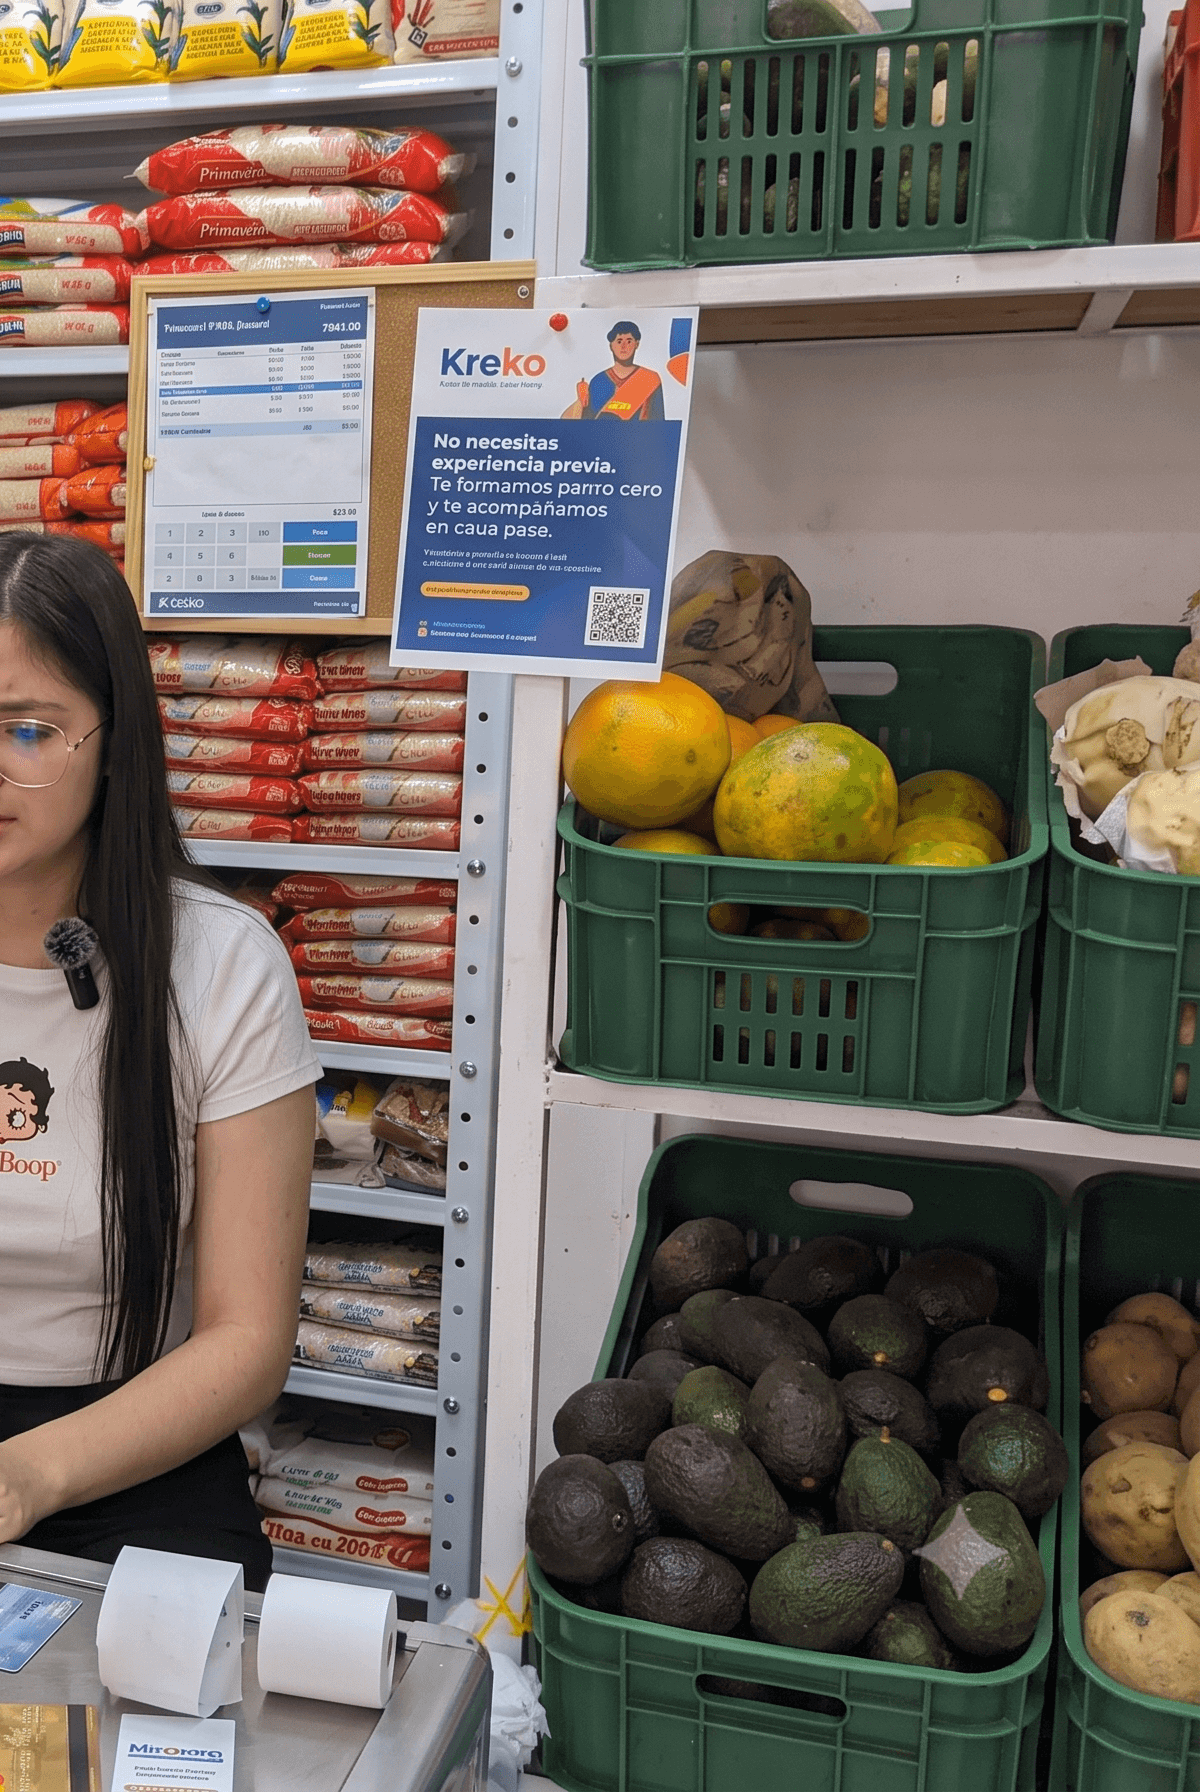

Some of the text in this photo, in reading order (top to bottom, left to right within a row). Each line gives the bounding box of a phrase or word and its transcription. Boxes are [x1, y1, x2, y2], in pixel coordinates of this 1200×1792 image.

[440, 347, 546, 377] Kreko
[433, 433, 559, 452] No necesitas
[431, 455, 617, 476] experiencia previa.
[430, 476, 452, 492] Te
[456, 477, 553, 495] formamos
[619, 481, 663, 498] cero
[426, 502, 440, 517] y
[444, 501, 462, 514] te
[167, 530, 173, 538] 1
[198, 530, 204, 538] 2
[229, 529, 236, 537] 3
[425, 521, 449, 535] en
[503, 522, 553, 540] pase.
[167, 552, 173, 560] 4
[197, 552, 204, 560] 5
[228, 552, 235, 560] 6
[166, 575, 172, 583] 2
[228, 574, 235, 582] 3
